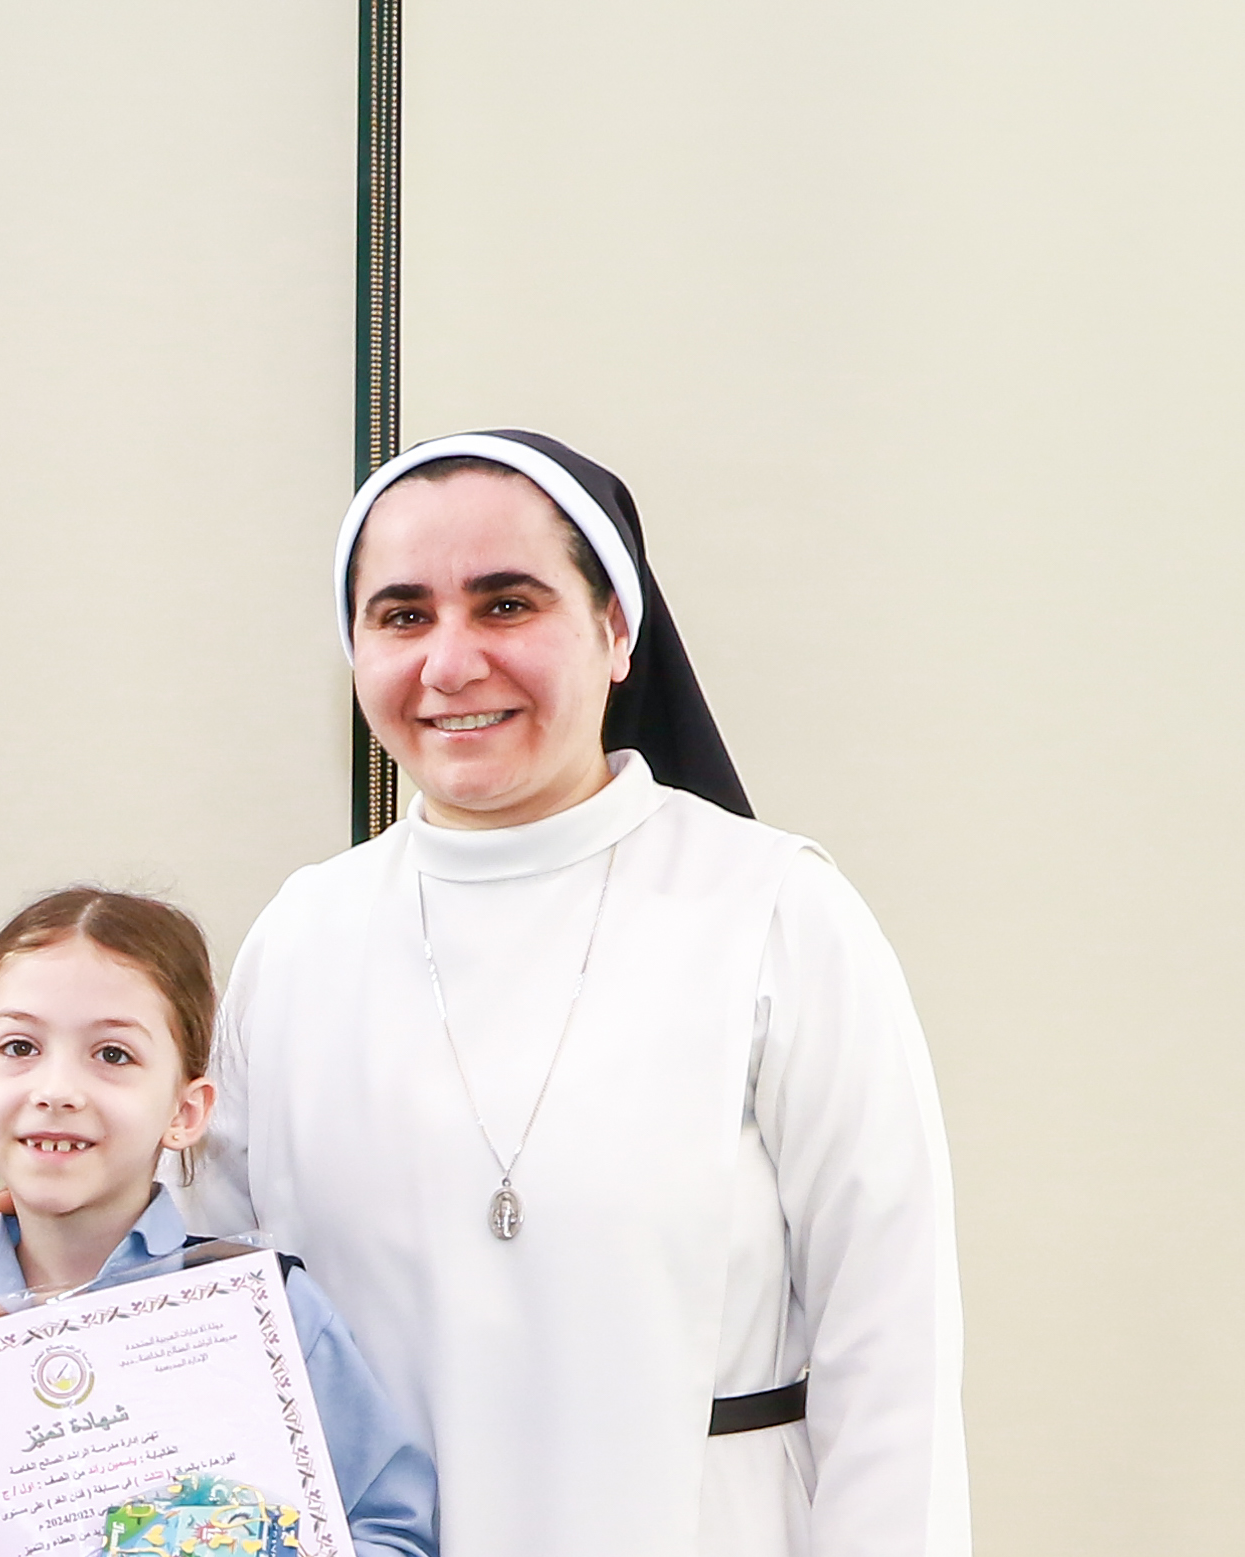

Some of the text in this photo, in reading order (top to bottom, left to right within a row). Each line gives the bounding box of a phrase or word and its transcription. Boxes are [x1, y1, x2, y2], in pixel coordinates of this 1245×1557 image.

[69, 1404, 129, 1433] شهادة
[91, 1443, 119, 1453] مدرسة
[10, 1462, 36, 1474] الخاصة
[107, 1457, 137, 1471] ياسمين
[44, 1472, 69, 1485] الصف
[73, 1471, 85, 1480] من
[93, 1484, 119, 1494] مسابقة
[122, 1477, 132, 1490] في
[30, 1501, 44, 1514] على
[2, 1508, 28, 1521] مستوى
[79, 1532, 91, 1541] من
